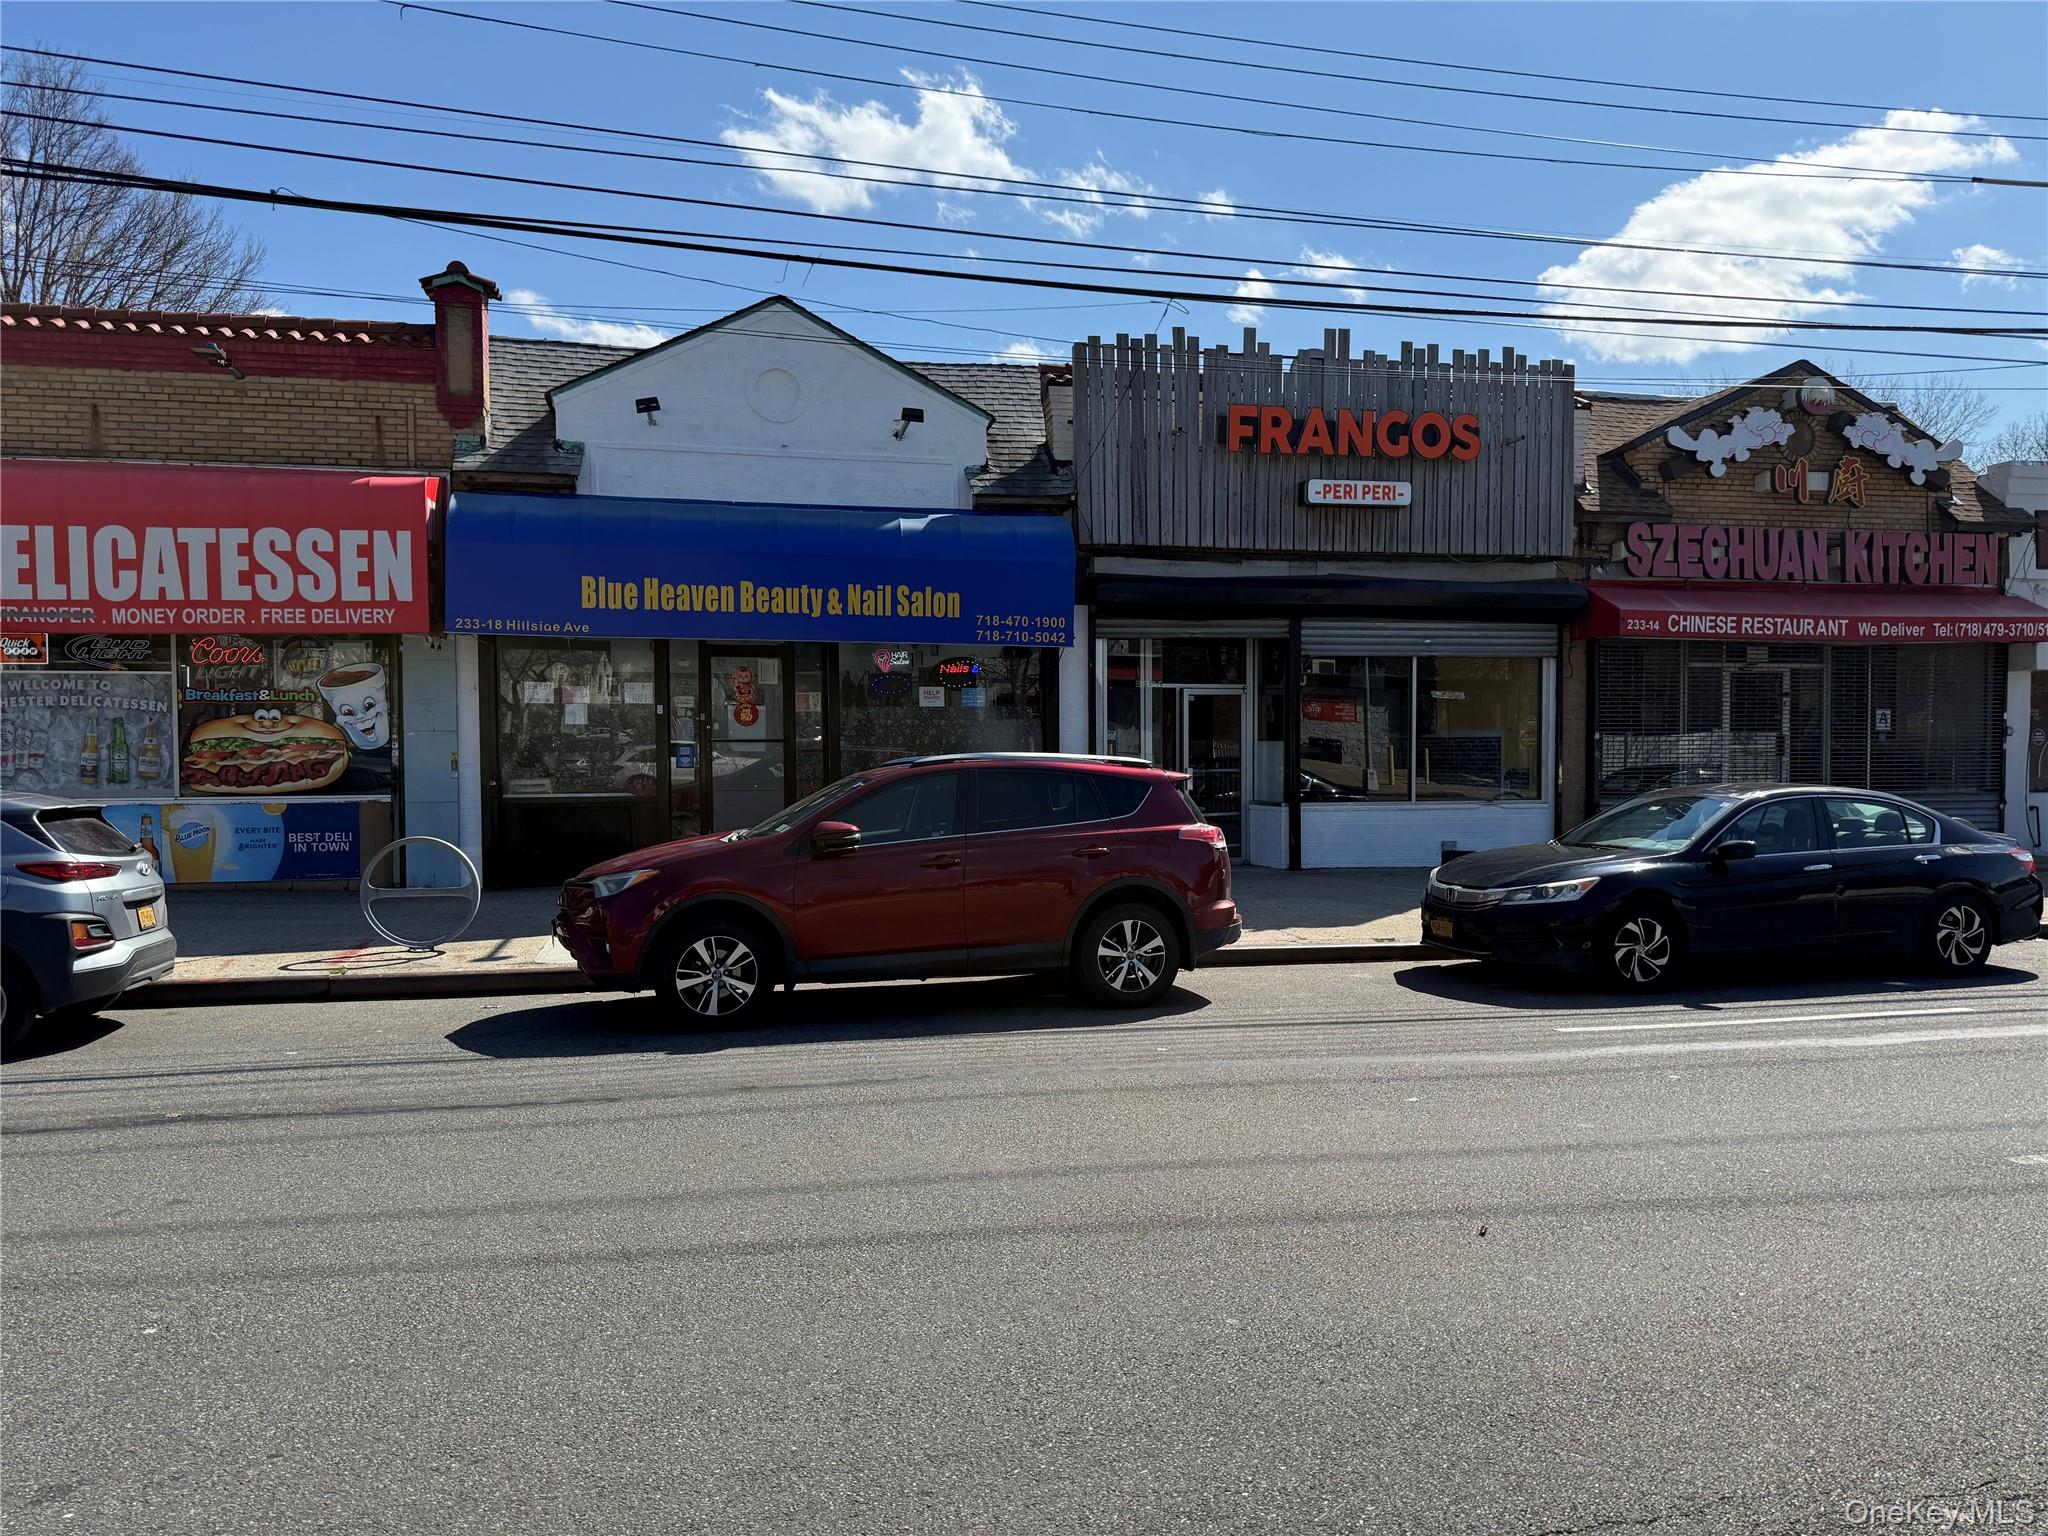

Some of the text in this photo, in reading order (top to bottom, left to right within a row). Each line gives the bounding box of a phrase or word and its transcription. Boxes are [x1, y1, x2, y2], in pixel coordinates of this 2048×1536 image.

[1227, 403, 1481, 461] FRANGOS
[1627, 521, 2000, 585] SZECHUAN KITCHEN
[0, 525, 413, 603] ELICATESSEN
[581, 575, 961, 618] Blue Heaven Beauty & Nail Salon
[111, 608, 177, 625] MONEY
[181, 608, 245, 625] ORDER
[260, 608, 307, 625] FREE
[311, 608, 395, 625] DELIVERY
[455, 617, 503, 630] 233-18
[563, 621, 590, 634] Ave
[1627, 619, 1659, 631] 233-14
[1667, 615, 1737, 634] CHINESE
[1741, 616, 1848, 637] RESTAURANT
[1857, 622, 1878, 636] We
[1880, 622, 1926, 638] Deliver
[0, 637, 30, 648] Quick
[90, 638, 150, 649] BUD
[976, 629, 1066, 644] 718-710-5042
[76, 647, 152, 660] LIGHT
[191, 635, 268, 665] Coors
[938, 663, 970, 673] Nails
[7, 679, 112, 691] WELCOME TO
[59, 695, 169, 713] DELICATESSEN
[1878, 711, 1889, 724] A
[175, 826, 211, 843] BLUE MOON
[288, 832, 353, 843] BEST DELI
[294, 842, 350, 852] IN TOWN
